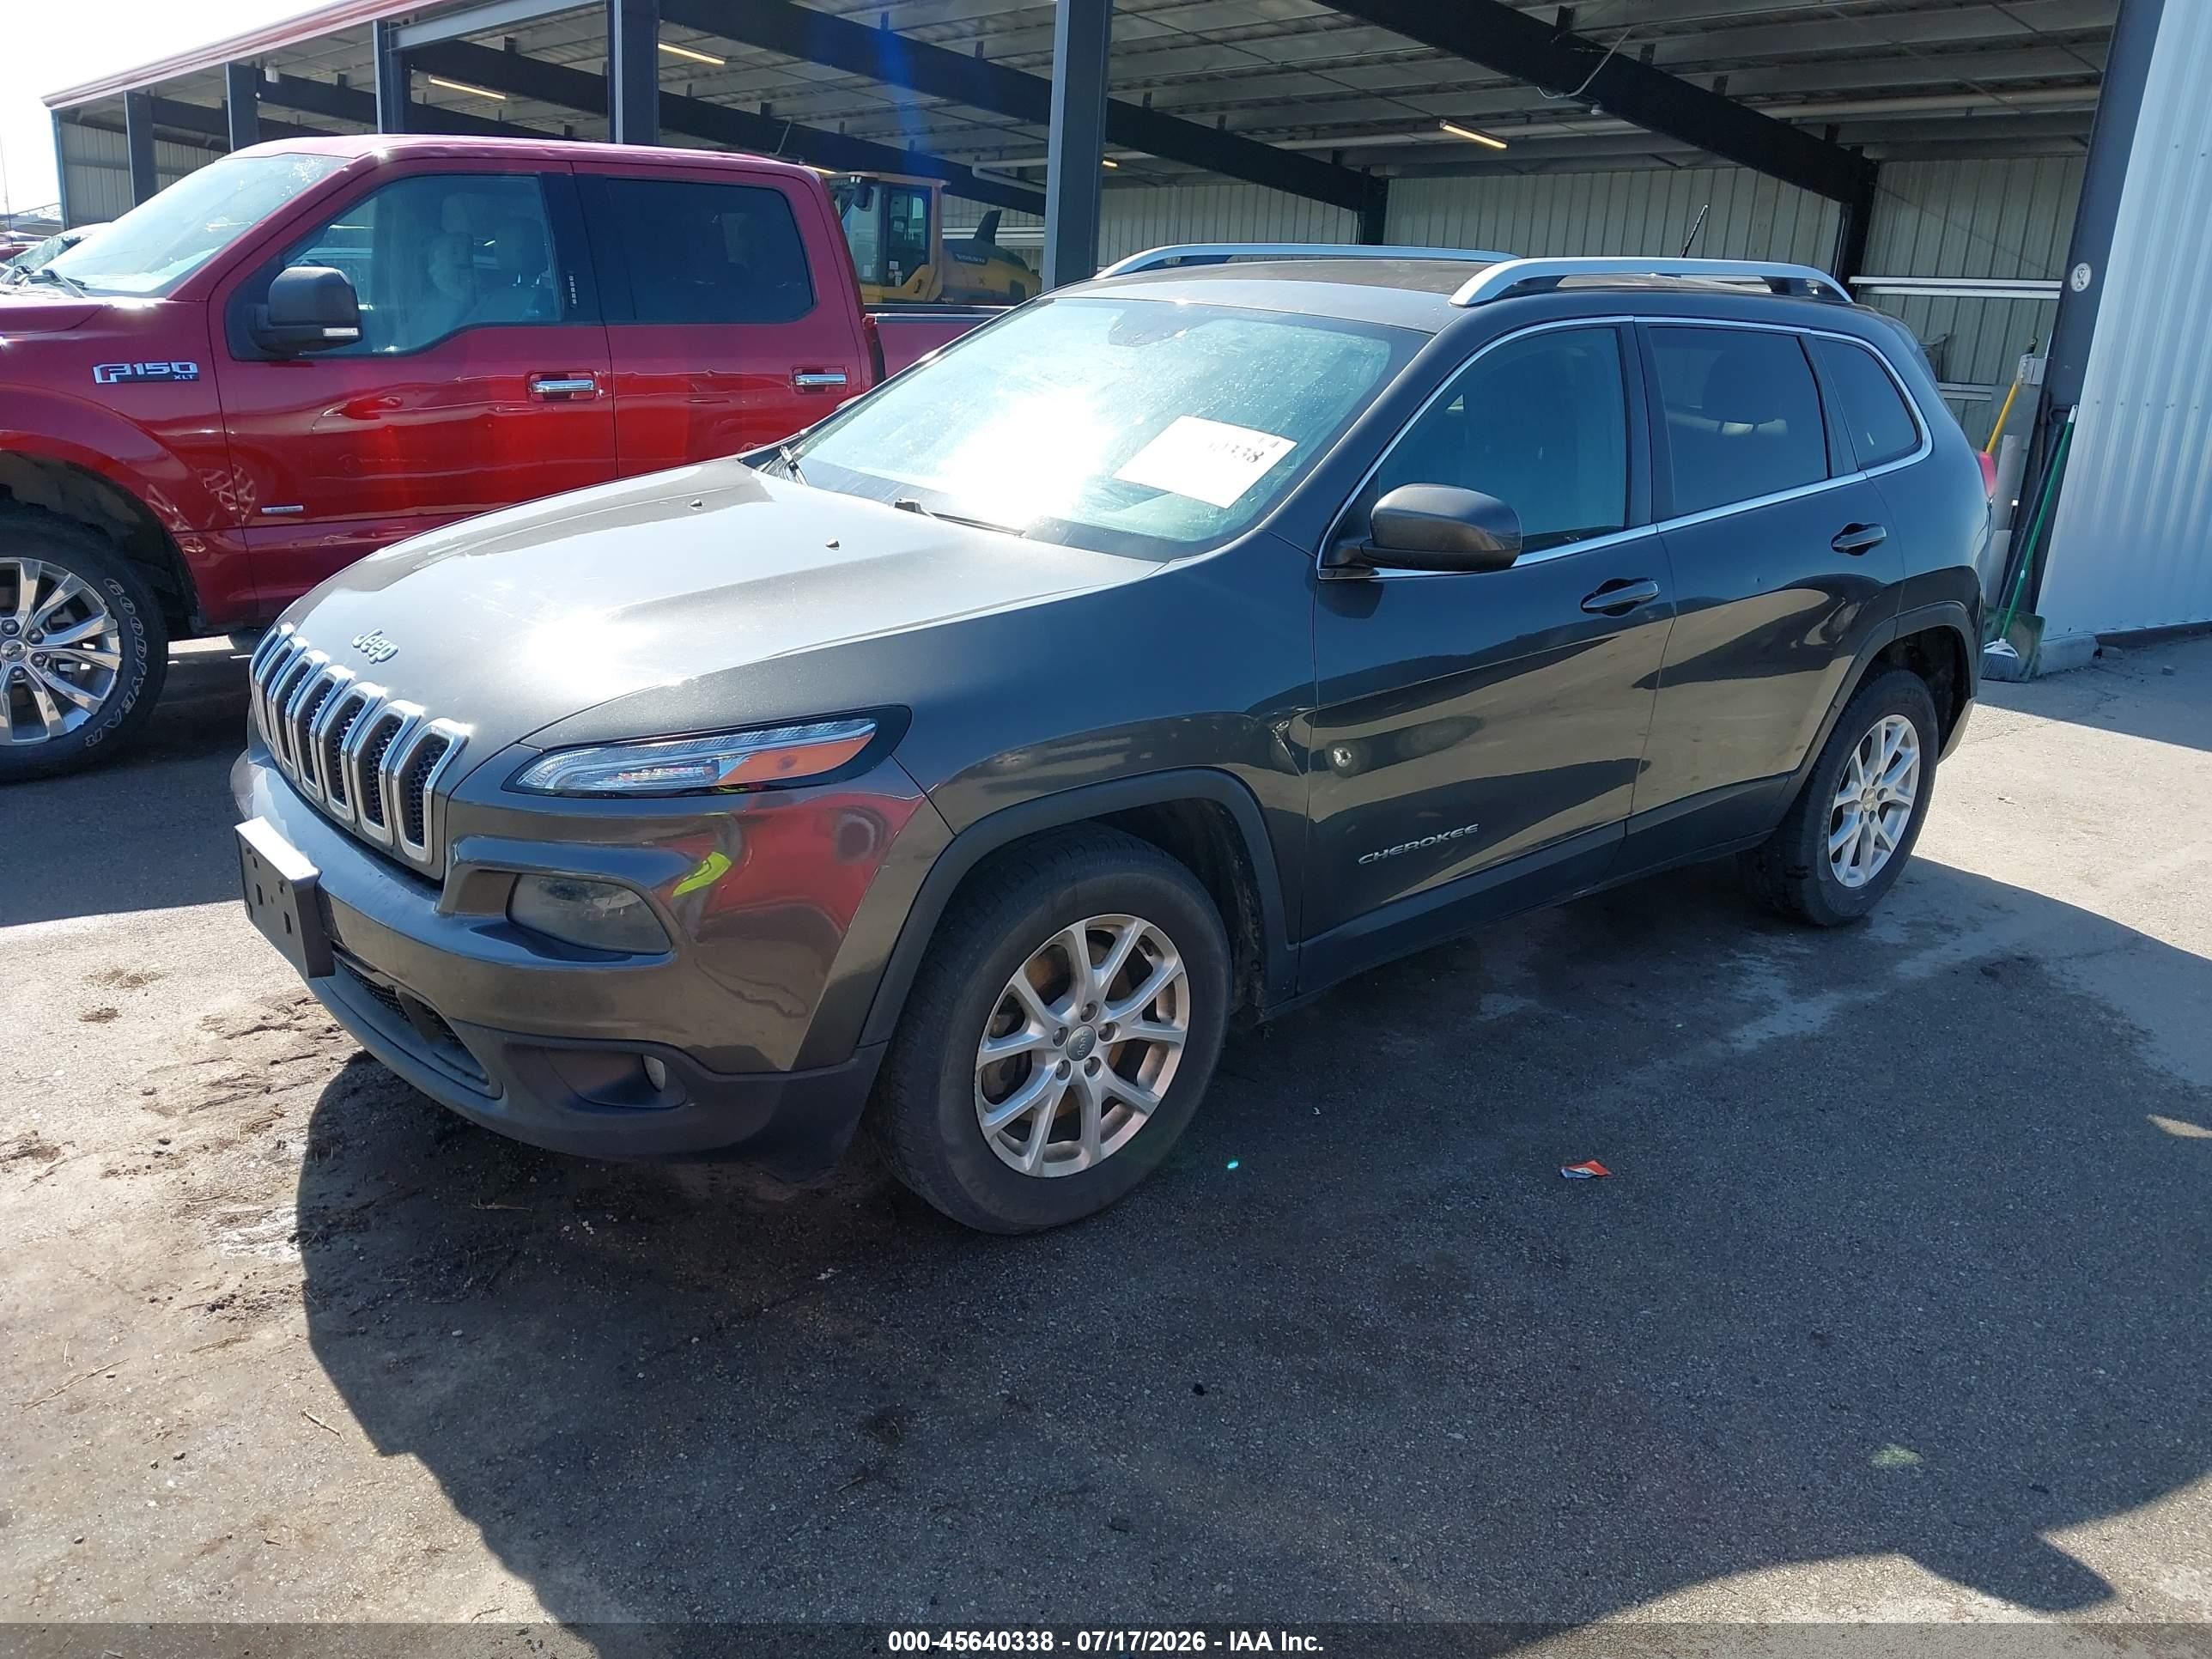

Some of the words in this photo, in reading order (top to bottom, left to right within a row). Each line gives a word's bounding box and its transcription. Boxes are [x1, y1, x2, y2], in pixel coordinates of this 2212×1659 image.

[85, 578, 148, 747] GOODYEAR
[351, 629, 399, 665] Jeep
[1358, 823, 1480, 865] CHEROKEE
